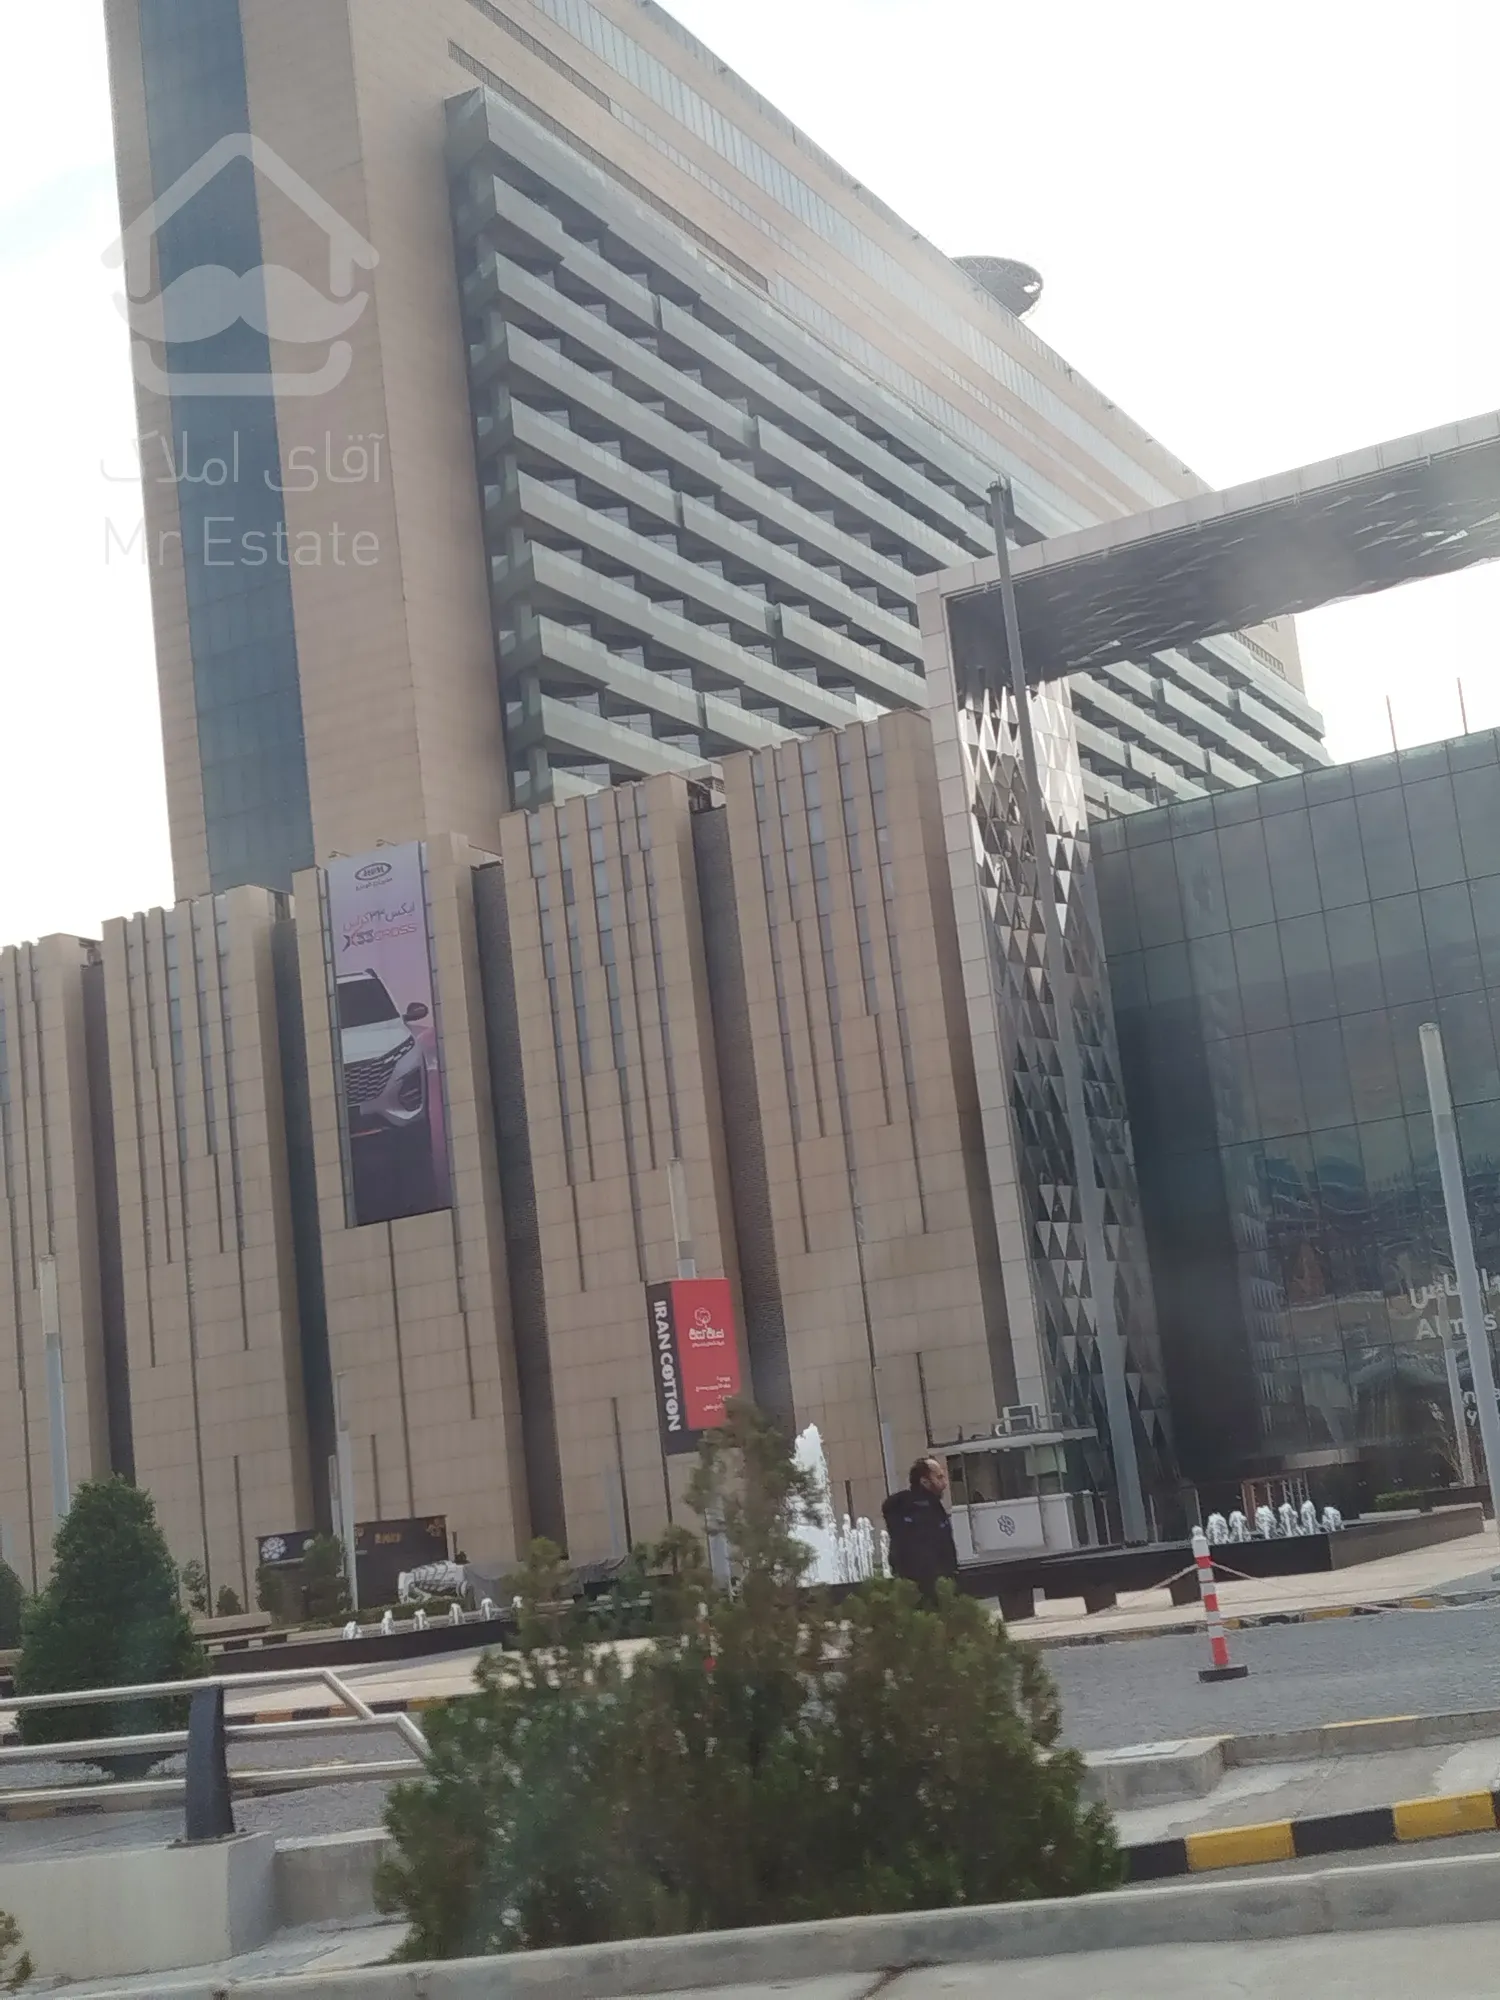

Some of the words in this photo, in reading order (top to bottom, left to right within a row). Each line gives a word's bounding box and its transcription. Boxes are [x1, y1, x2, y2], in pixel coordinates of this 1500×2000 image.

[653, 1300, 672, 1350] IRAN
[1415, 1313, 1498, 1341] Alms
[659, 1352, 682, 1432] COTTON
